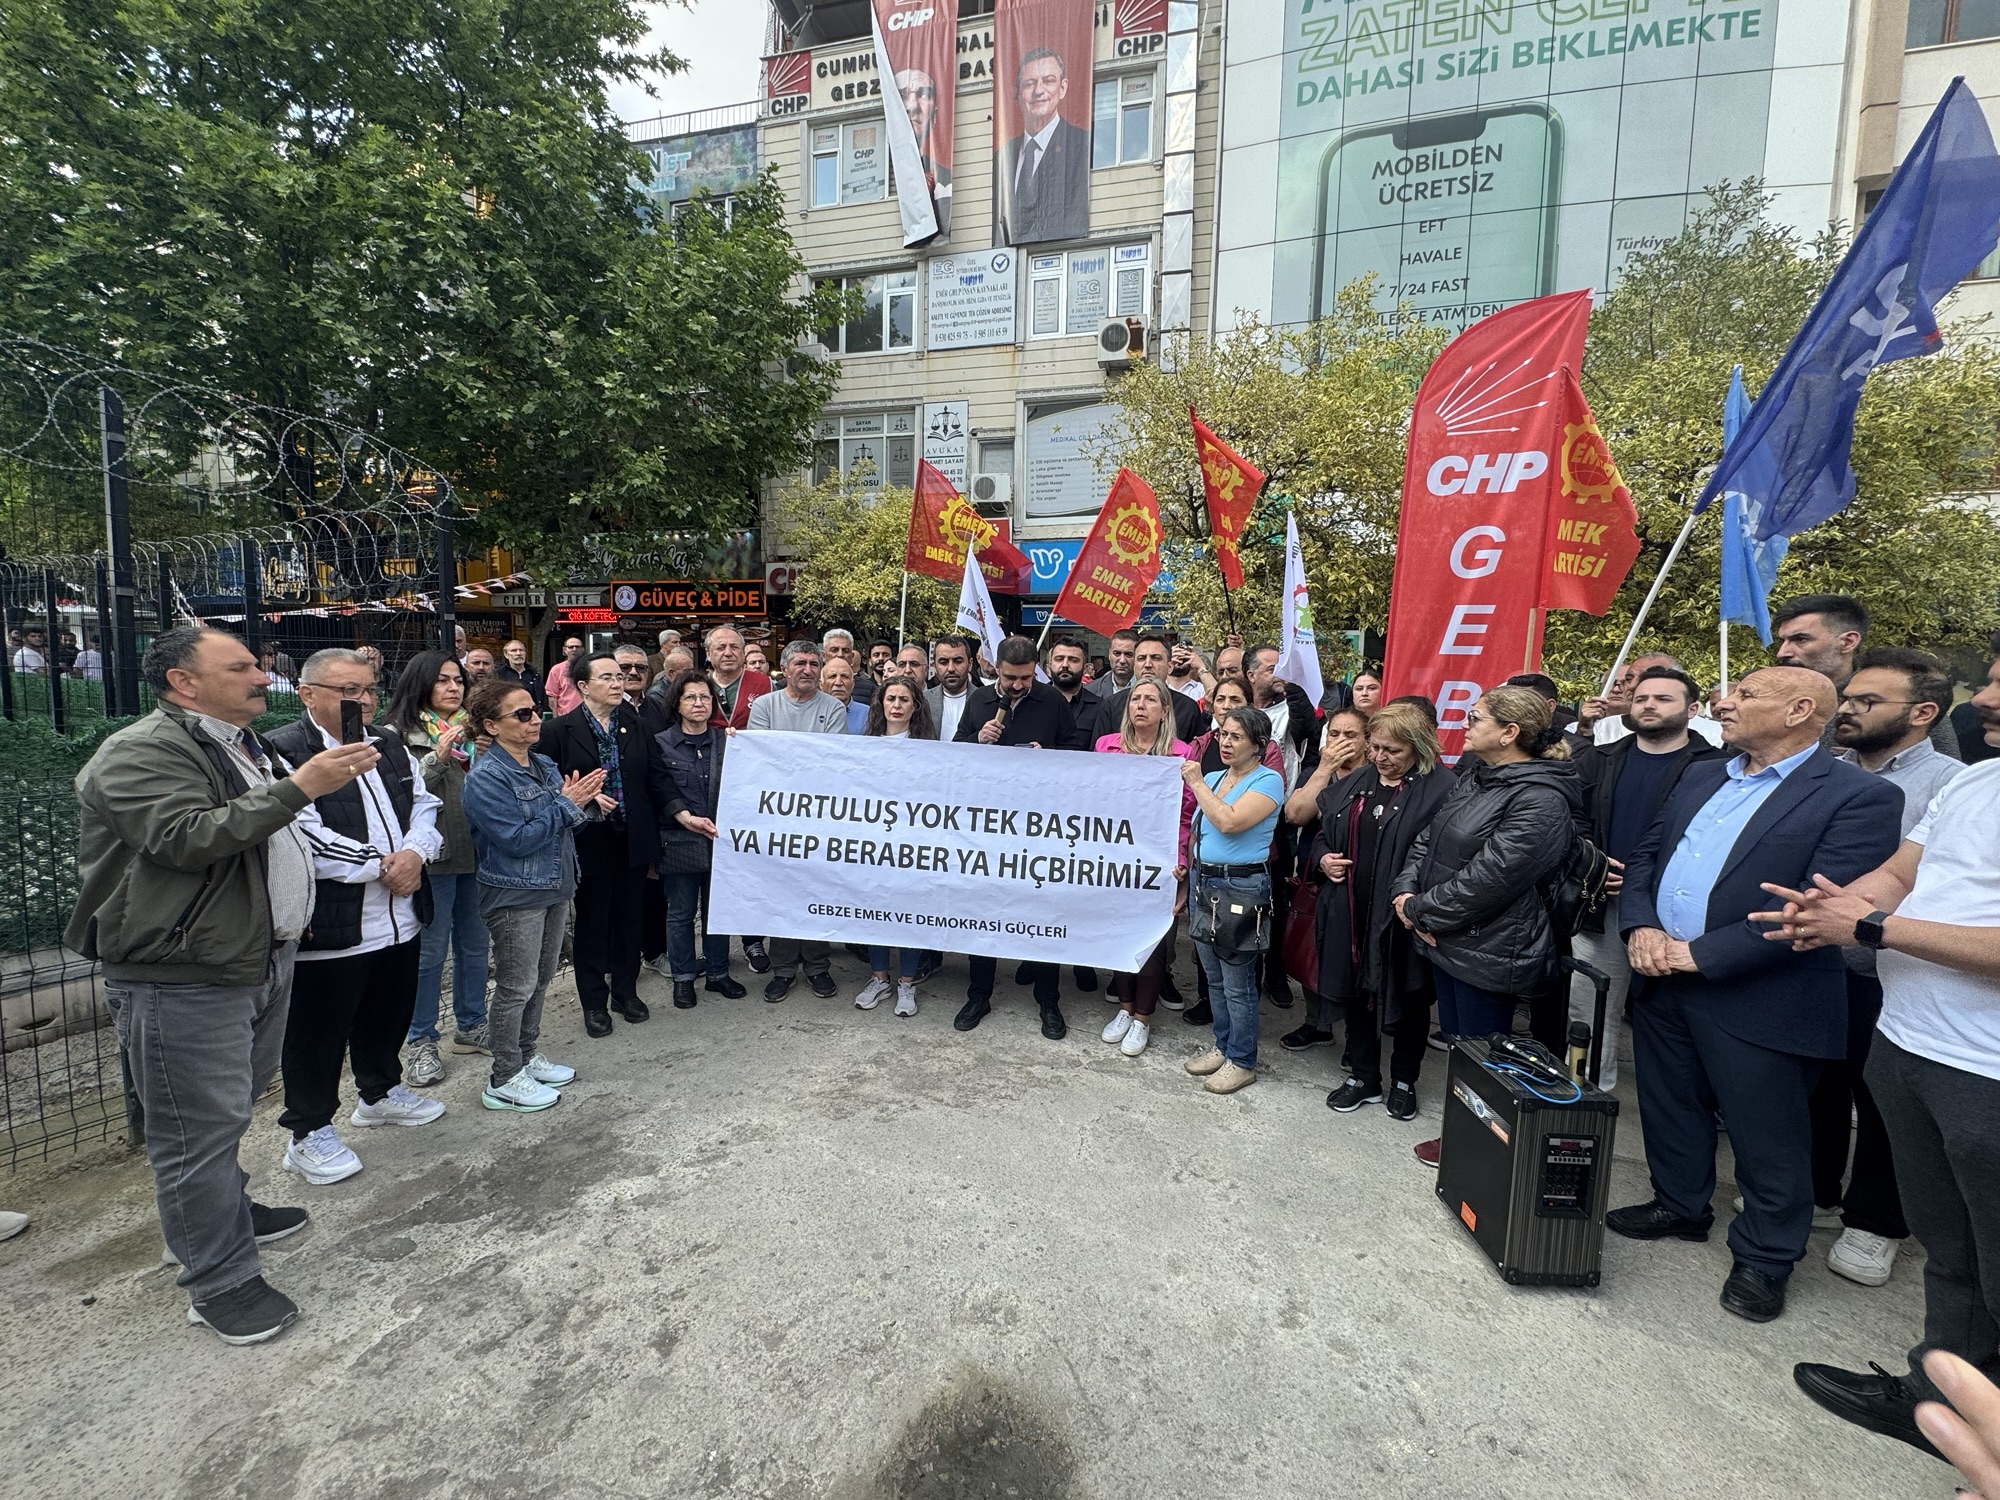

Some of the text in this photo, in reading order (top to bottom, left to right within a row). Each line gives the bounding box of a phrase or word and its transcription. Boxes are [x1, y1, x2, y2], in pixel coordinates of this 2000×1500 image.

[887, 8, 935, 32] CHP
[1117, 34, 1164, 57] CHP
[1298, 0, 1514, 73] ZATEN
[1296, 58, 1424, 108] DAHASI
[1511, 9, 1761, 69] BEKLEMEKTE
[771, 95, 808, 116] CHP
[854, 148, 875, 160] CHP
[1371, 143, 1503, 180] MOBİLDEN
[1378, 171, 1494, 206] ÜCRETSİZ
[1419, 218, 1447, 234] EFT
[1400, 247, 1462, 266] HAVALE
[1077, 279, 1101, 296] EG
[1389, 278, 1470, 299] 7/24 FAST
[925, 446, 965, 455] AVUKAT
[1571, 443, 1615, 479] EMP
[1426, 450, 1548, 496] CHP
[953, 512, 987, 534] EMEP
[1118, 521, 1150, 548] EMEP
[1556, 518, 1609, 546] MEK
[925, 545, 954, 565] EMEK
[1090, 565, 1135, 595] EMEK
[558, 594, 588, 605] CAFE
[639, 586, 760, 610] GÜVEÇ & PİDE
[1073, 581, 1133, 618] PARTİSİ
[758, 790, 1135, 848] KURTULUŞ YOK TEK BAŞINA
[729, 828, 1162, 891] YA HEP BERABER YA HİÇBİRİMİZ
[807, 903, 1068, 939] GEBZE EMEK VE DEMOKRASİ GÜÇLERİ
